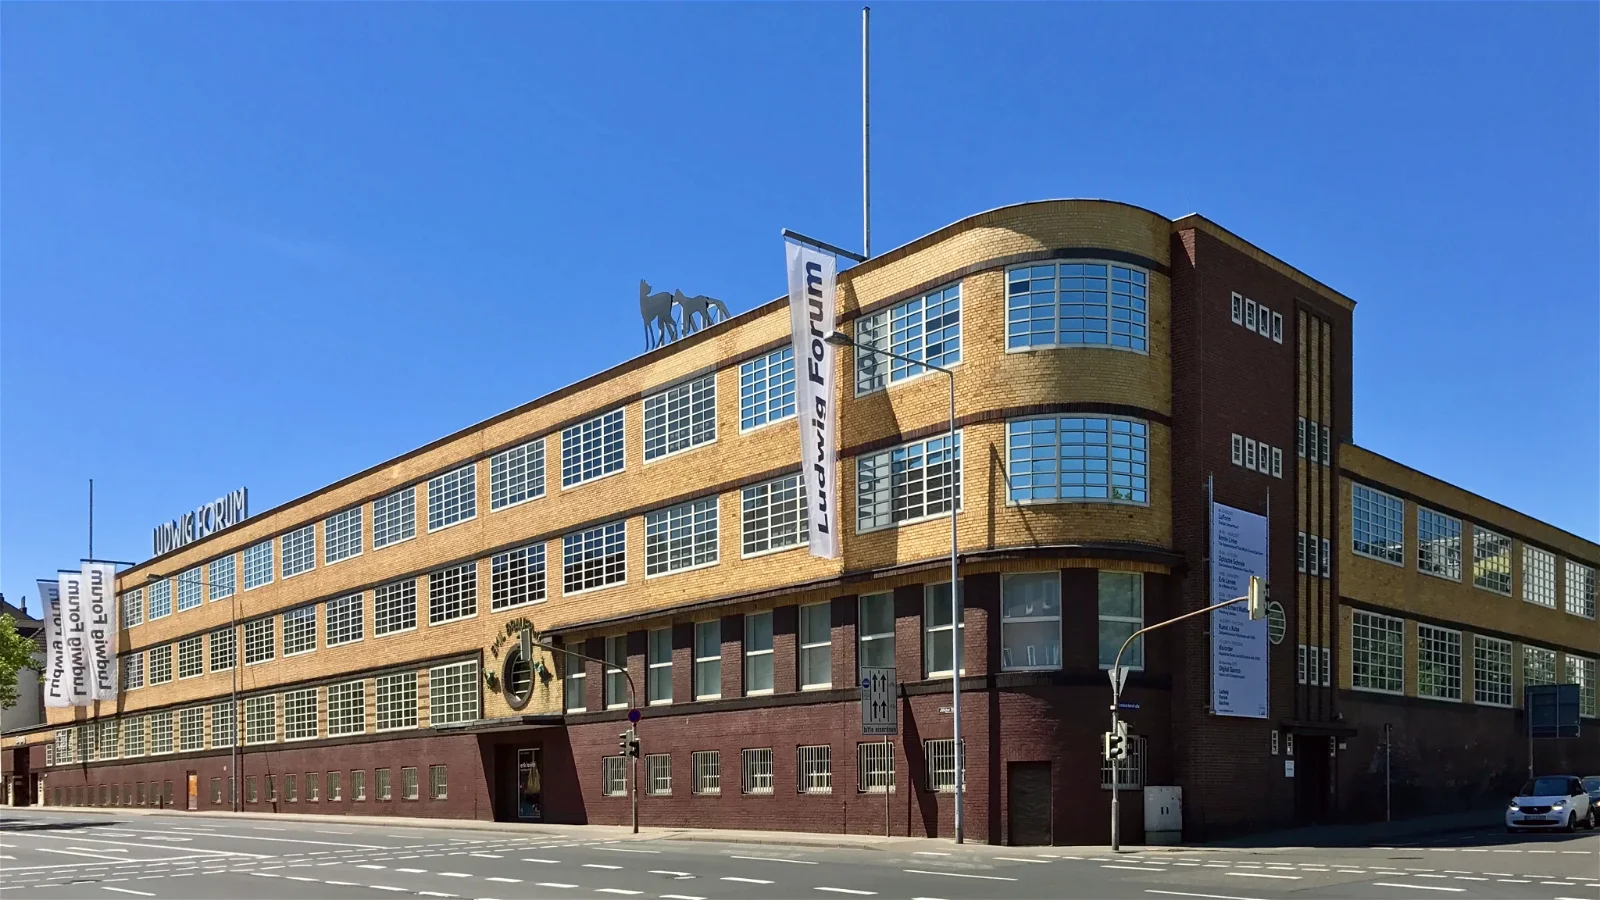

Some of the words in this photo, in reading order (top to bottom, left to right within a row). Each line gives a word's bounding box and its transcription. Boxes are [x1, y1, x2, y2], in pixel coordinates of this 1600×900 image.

[805, 260, 825, 388] Forum
[152, 510, 195, 558] LUDWIG
[196, 486, 248, 541] FORUM
[809, 395, 829, 535] Ludwig
